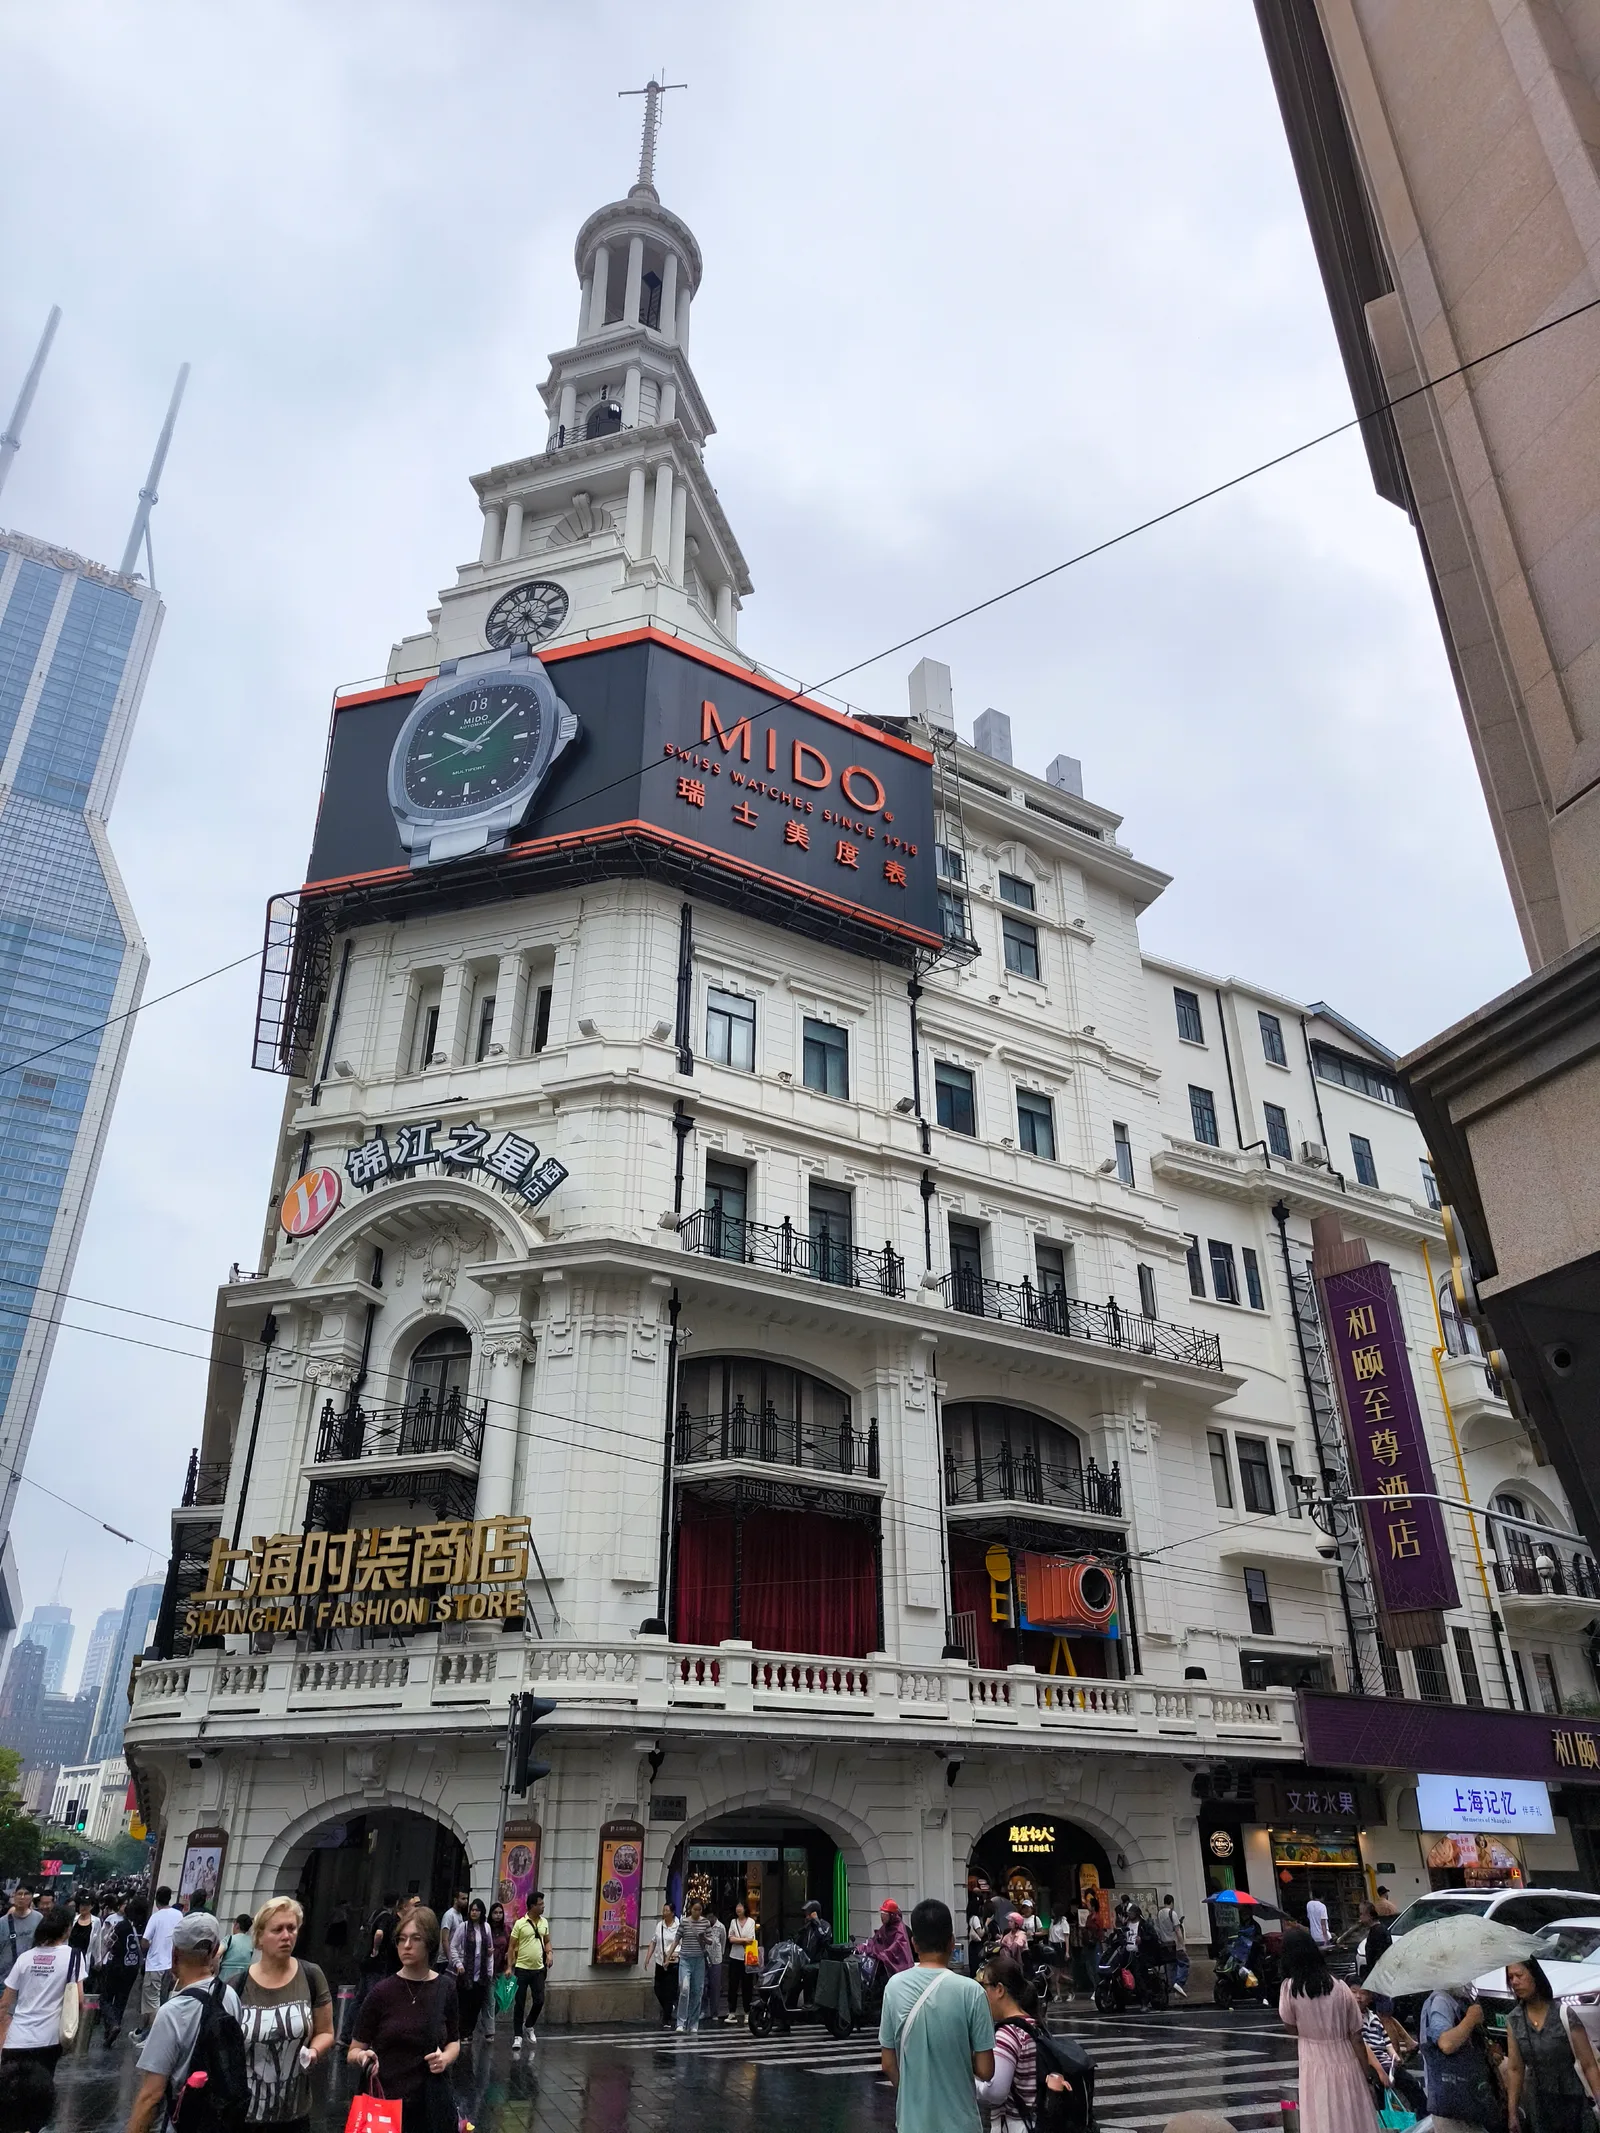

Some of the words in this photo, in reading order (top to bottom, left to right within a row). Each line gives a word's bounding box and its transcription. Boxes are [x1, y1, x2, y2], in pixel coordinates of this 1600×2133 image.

[459, 719, 492, 730] AUTOMATIC
[463, 714, 489, 725] MIDO
[469, 697, 488, 713] 08
[452, 764, 487, 775] MULTIFORT
[701, 700, 887, 814] MIDO
[664, 743, 721, 775] SWISS
[730, 770, 814, 813] WATCHES
[822, 809, 876, 839] SINCE
[883, 834, 919, 857] 1918
[676, 776, 908, 888] 瑞士美度表
[346, 1121, 538, 1187] 锦江之星
[521, 1158, 569, 1206] 酒店
[1345, 1304, 1421, 1561] 和颐至尊酒店
[190, 1515, 532, 1601] 上海时装商店
[183, 1604, 305, 1636] SHANGHAI
[316, 1597, 430, 1628] FASHION
[436, 1590, 526, 1621] STORE
[1286, 1790, 1356, 1815] 文龙水果
[1453, 1788, 1516, 1815] 上海记忆
